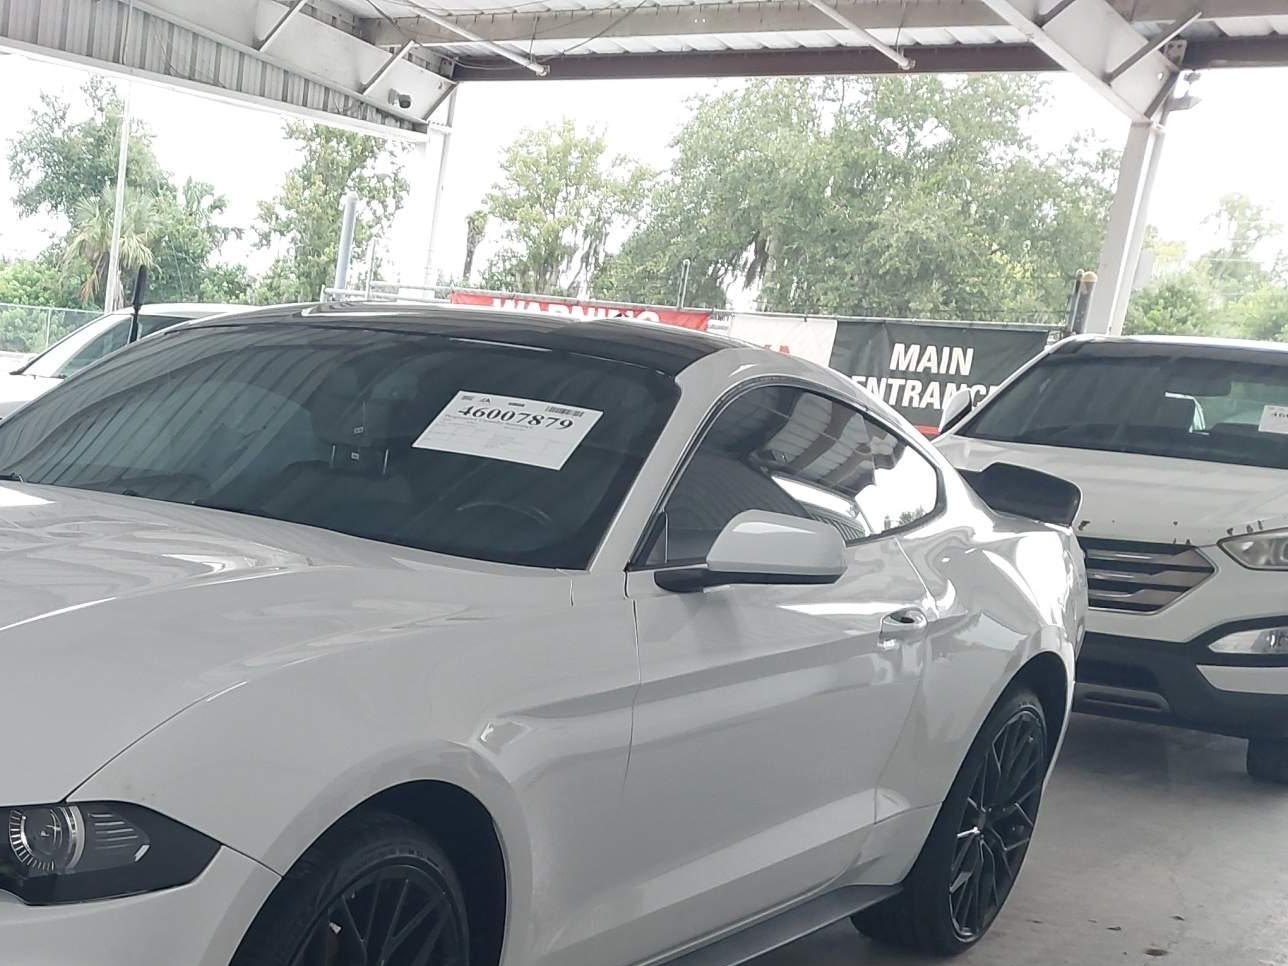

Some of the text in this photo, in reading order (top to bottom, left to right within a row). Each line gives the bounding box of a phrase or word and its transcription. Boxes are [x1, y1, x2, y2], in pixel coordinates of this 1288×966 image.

[889, 343, 974, 376] MAIN
[850, 376, 1002, 410] NTRAC
[458, 405, 574, 430] 46007879
